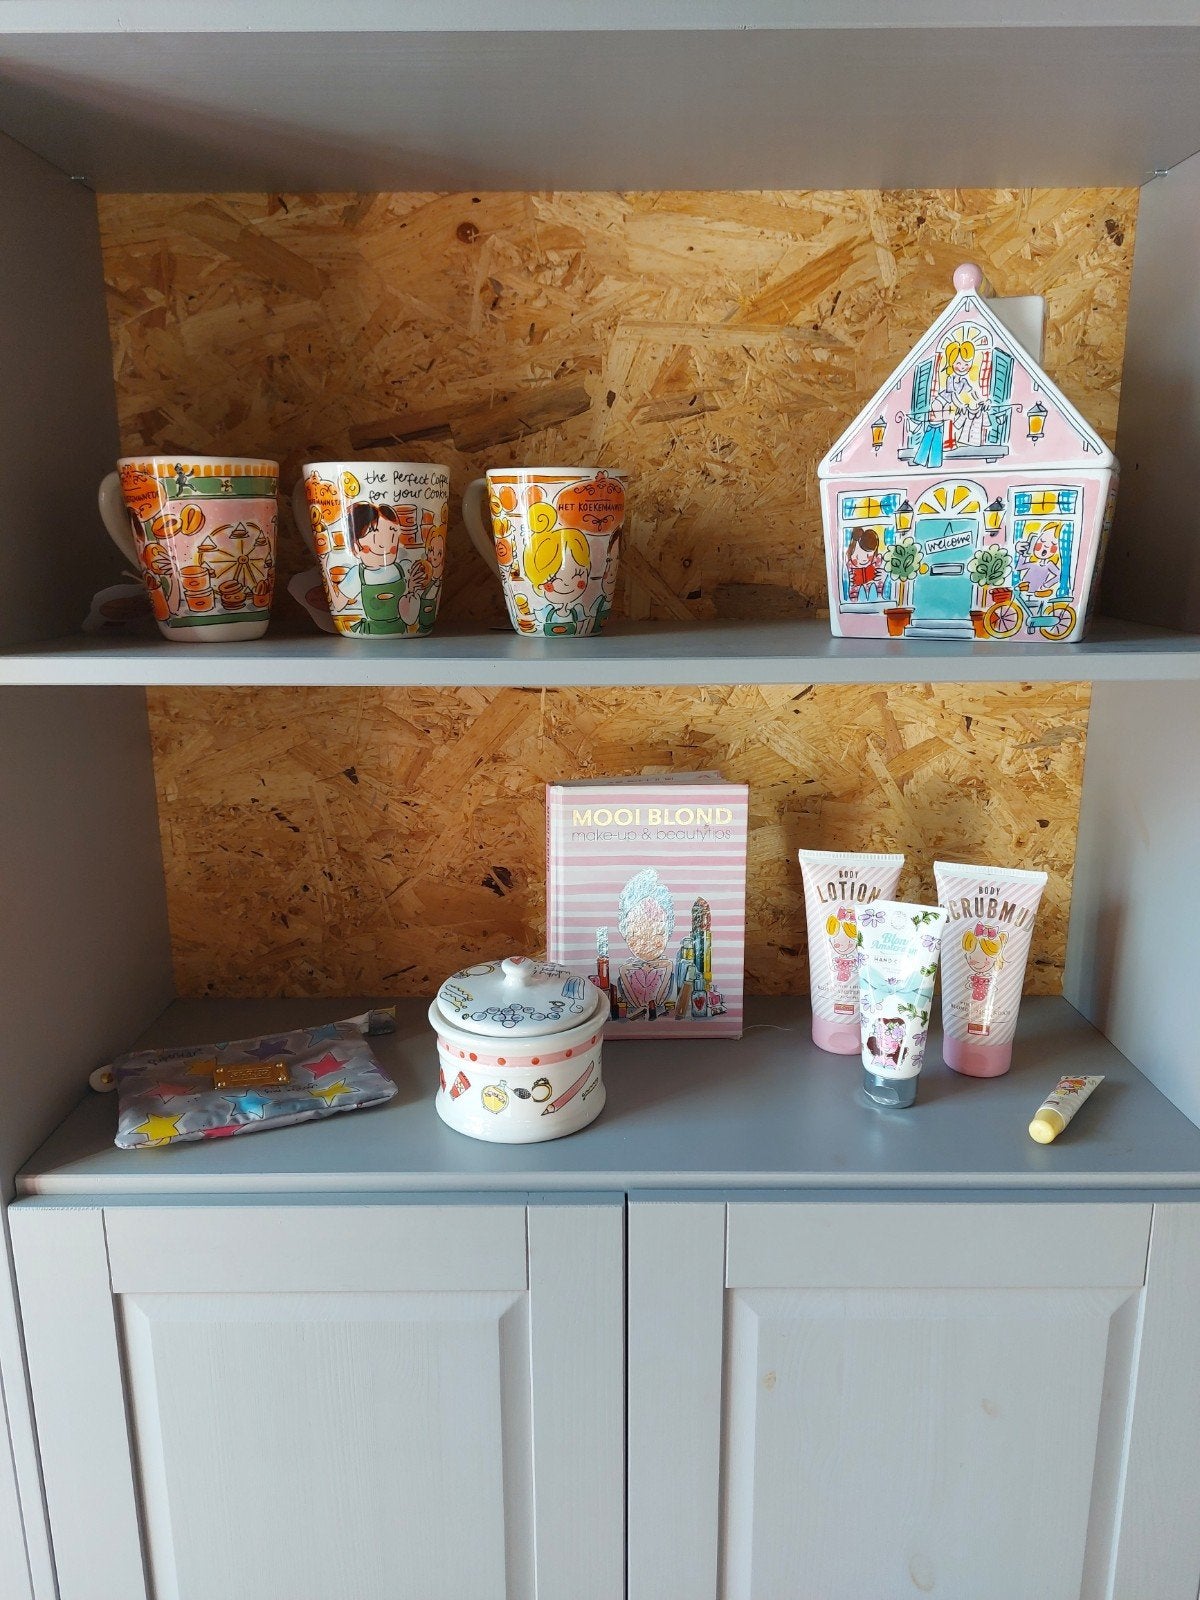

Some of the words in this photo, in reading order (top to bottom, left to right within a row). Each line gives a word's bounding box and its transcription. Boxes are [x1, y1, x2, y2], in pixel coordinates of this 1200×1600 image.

[364, 470, 388, 485] the
[368, 489, 389, 503] for
[393, 488, 422, 503] your
[558, 503, 576, 511] HET
[927, 534, 971, 552] welcome
[572, 808, 642, 827] MOOI
[647, 807, 734, 827] BLOND
[571, 829, 637, 842] make-up
[641, 827, 652, 841] &
[838, 870, 859, 879] BODY
[816, 881, 882, 904] LOTION
[978, 886, 1001, 896] BODY
